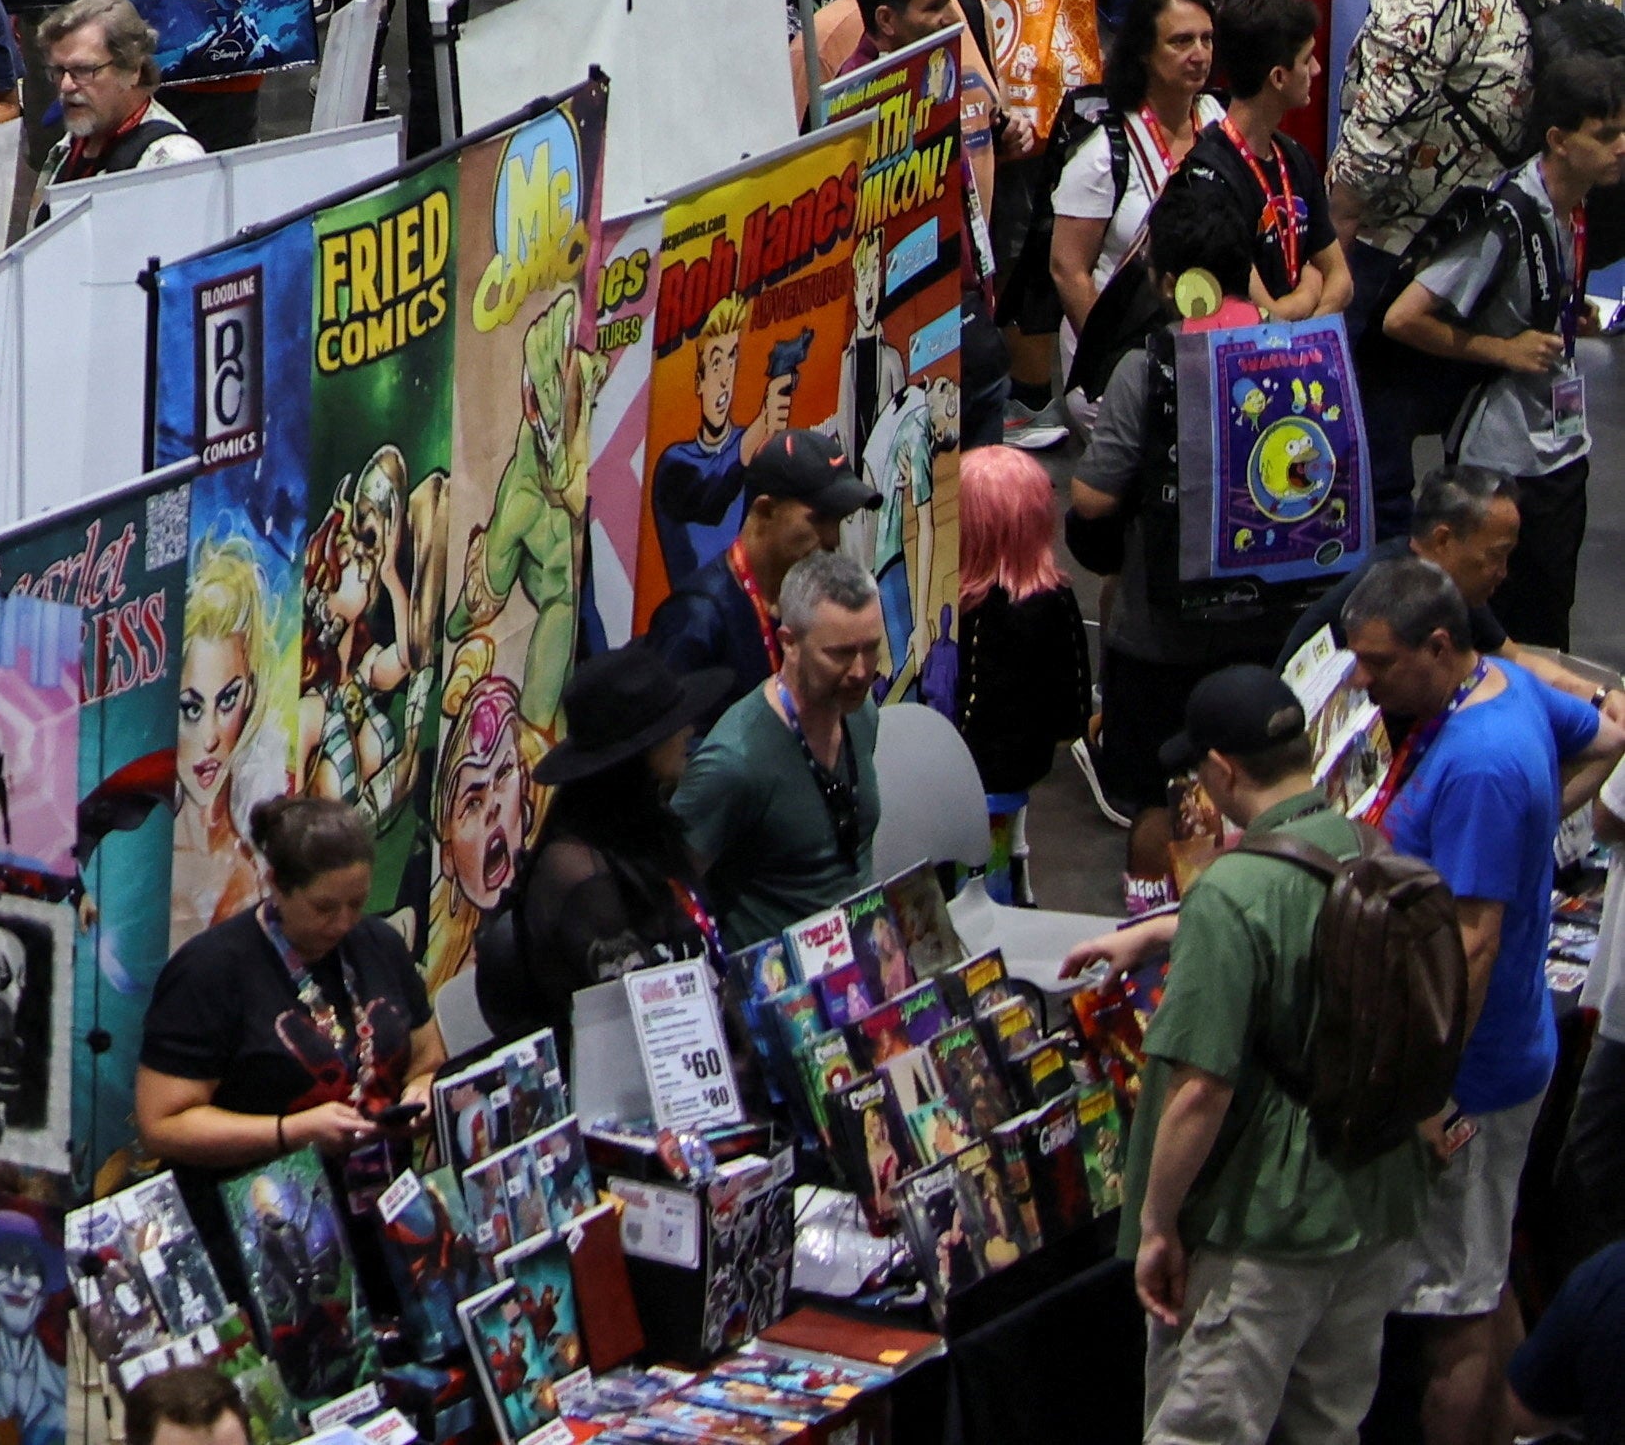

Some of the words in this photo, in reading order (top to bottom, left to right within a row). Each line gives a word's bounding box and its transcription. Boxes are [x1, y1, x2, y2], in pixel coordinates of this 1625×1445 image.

[322, 190, 451, 323] FRIED
[663, 235, 740, 346] Rob
[742, 163, 860, 290] Hanes
[201, 274, 256, 310] BLOODLINE
[317, 277, 447, 371] COMICS
[202, 431, 256, 465] COMICS
[680, 1047, 724, 1081] $60
[701, 1085, 730, 1109] $80
